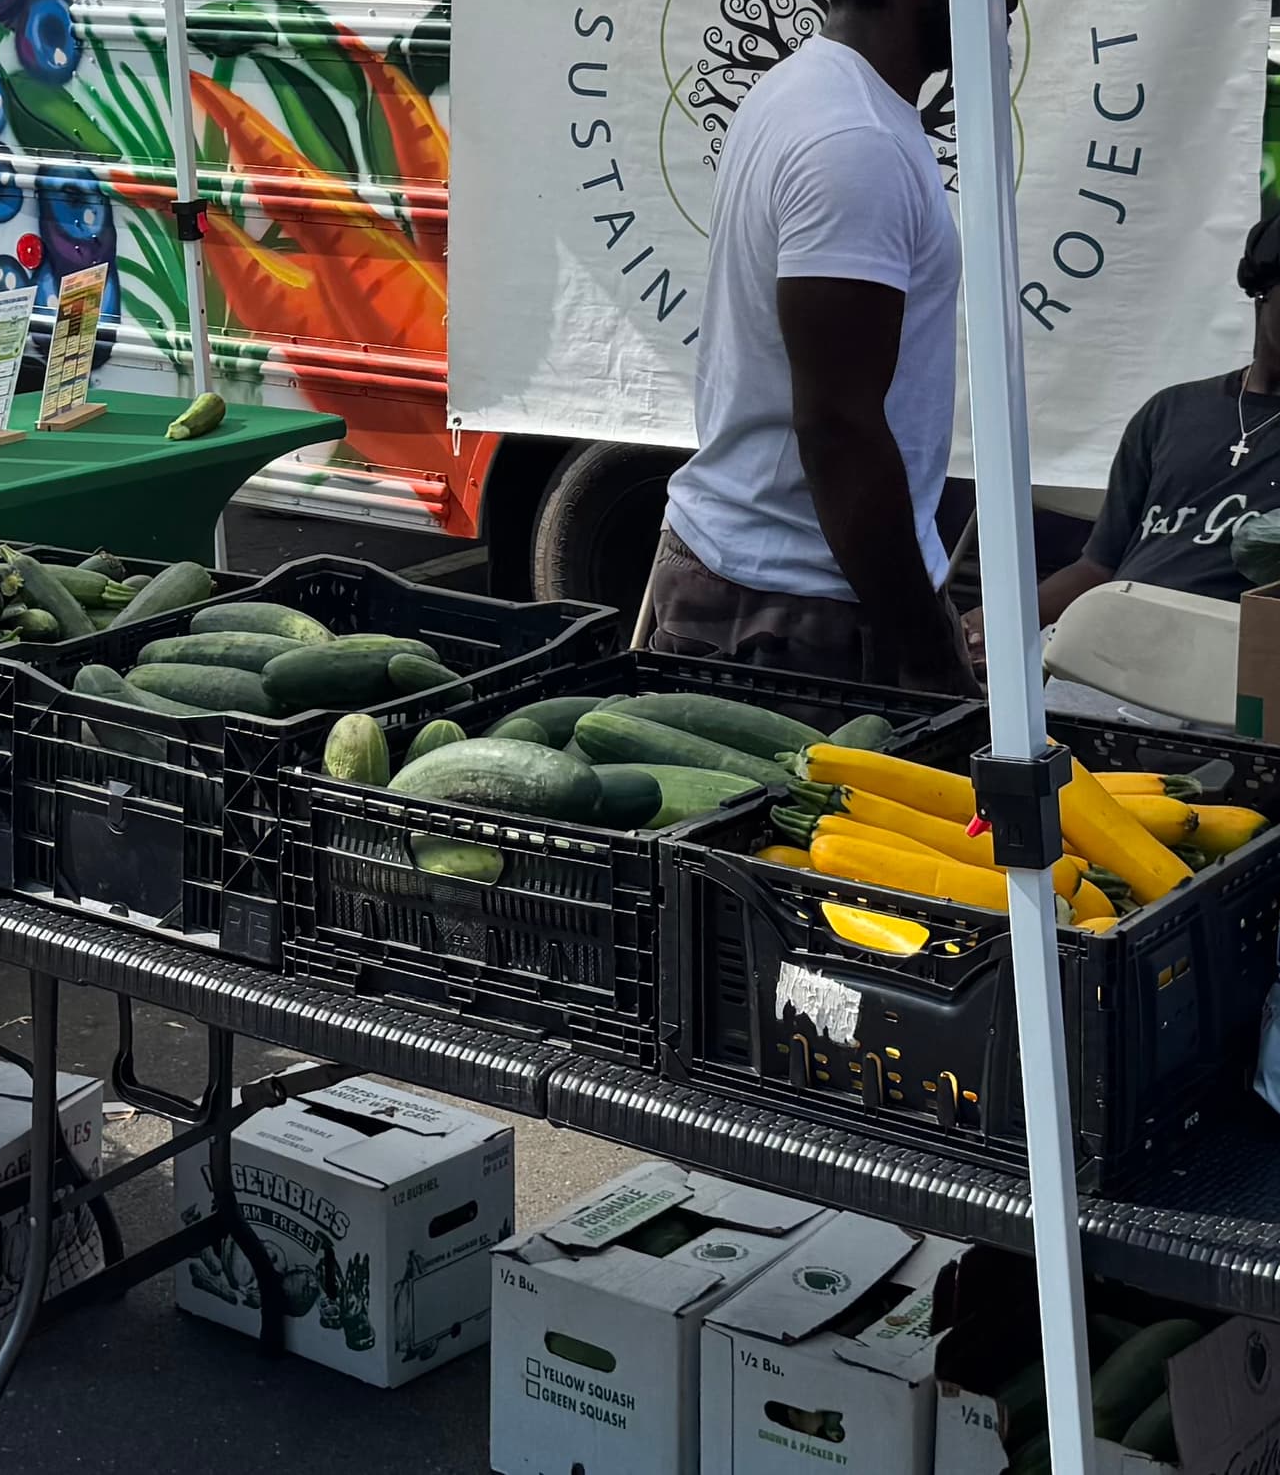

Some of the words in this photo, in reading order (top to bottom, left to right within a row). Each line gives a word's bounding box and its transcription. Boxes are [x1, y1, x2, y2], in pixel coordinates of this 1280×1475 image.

[567, 6, 701, 348] SUSTAIN
[1020, 26, 1145, 330] ROJECT
[1140, 505, 1197, 541] far
[402, 1110, 441, 1123] CARE
[201, 1163, 351, 1241] VGETABLES
[406, 1177, 440, 1201] BUSHEL
[569, 1188, 649, 1229] PERISHABLE
[272, 1214, 315, 1248] FRESH
[500, 1268, 515, 1286] 1/2
[519, 1275, 539, 1294] Bu.
[740, 1350, 758, 1367] 1/2
[762, 1358, 785, 1377] Bu.
[542, 1365, 585, 1392] YELLOW
[588, 1382, 635, 1411] SQUASH
[542, 1387, 577, 1412] GREEN
[579, 1400, 627, 1429] SQUASH
[961, 1404, 980, 1426] 1/2
[799, 1441, 834, 1461] PACKED
[834, 1452, 849, 1467] BY
